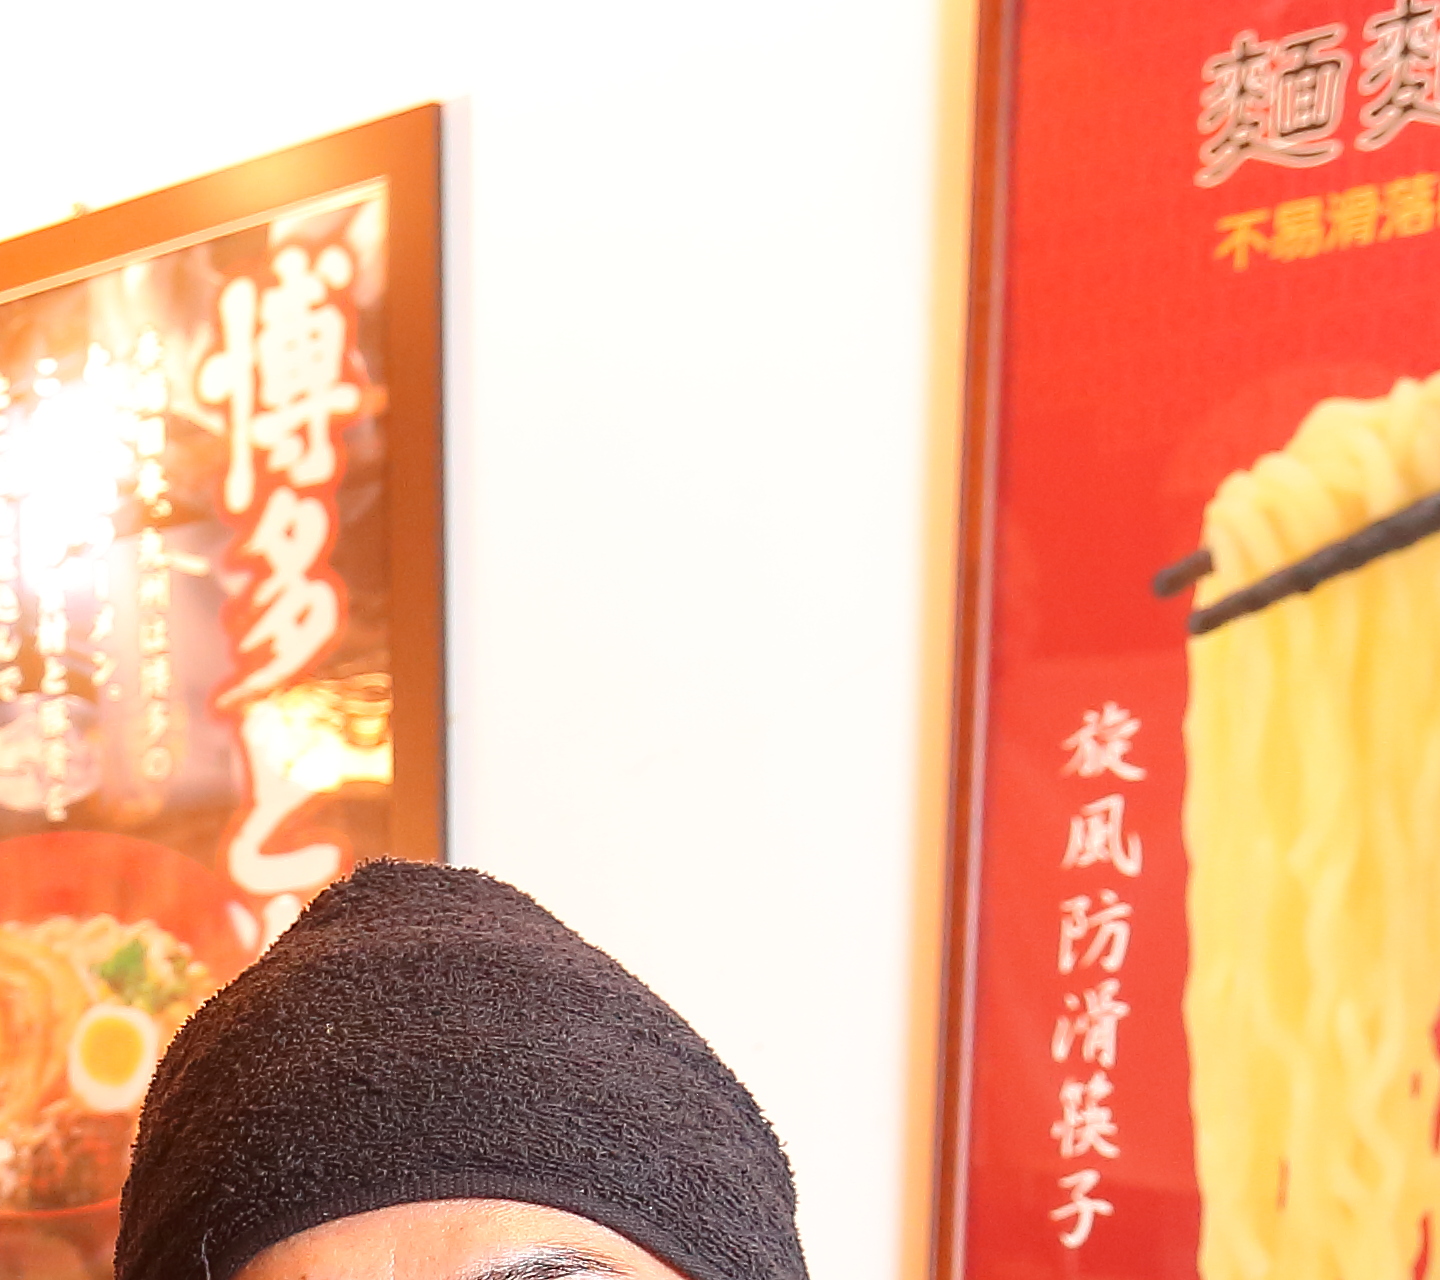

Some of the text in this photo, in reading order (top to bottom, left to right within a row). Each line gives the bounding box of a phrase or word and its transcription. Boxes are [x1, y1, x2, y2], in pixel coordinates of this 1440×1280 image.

[1049, 700, 1148, 1250] 旋風防滑筷子
